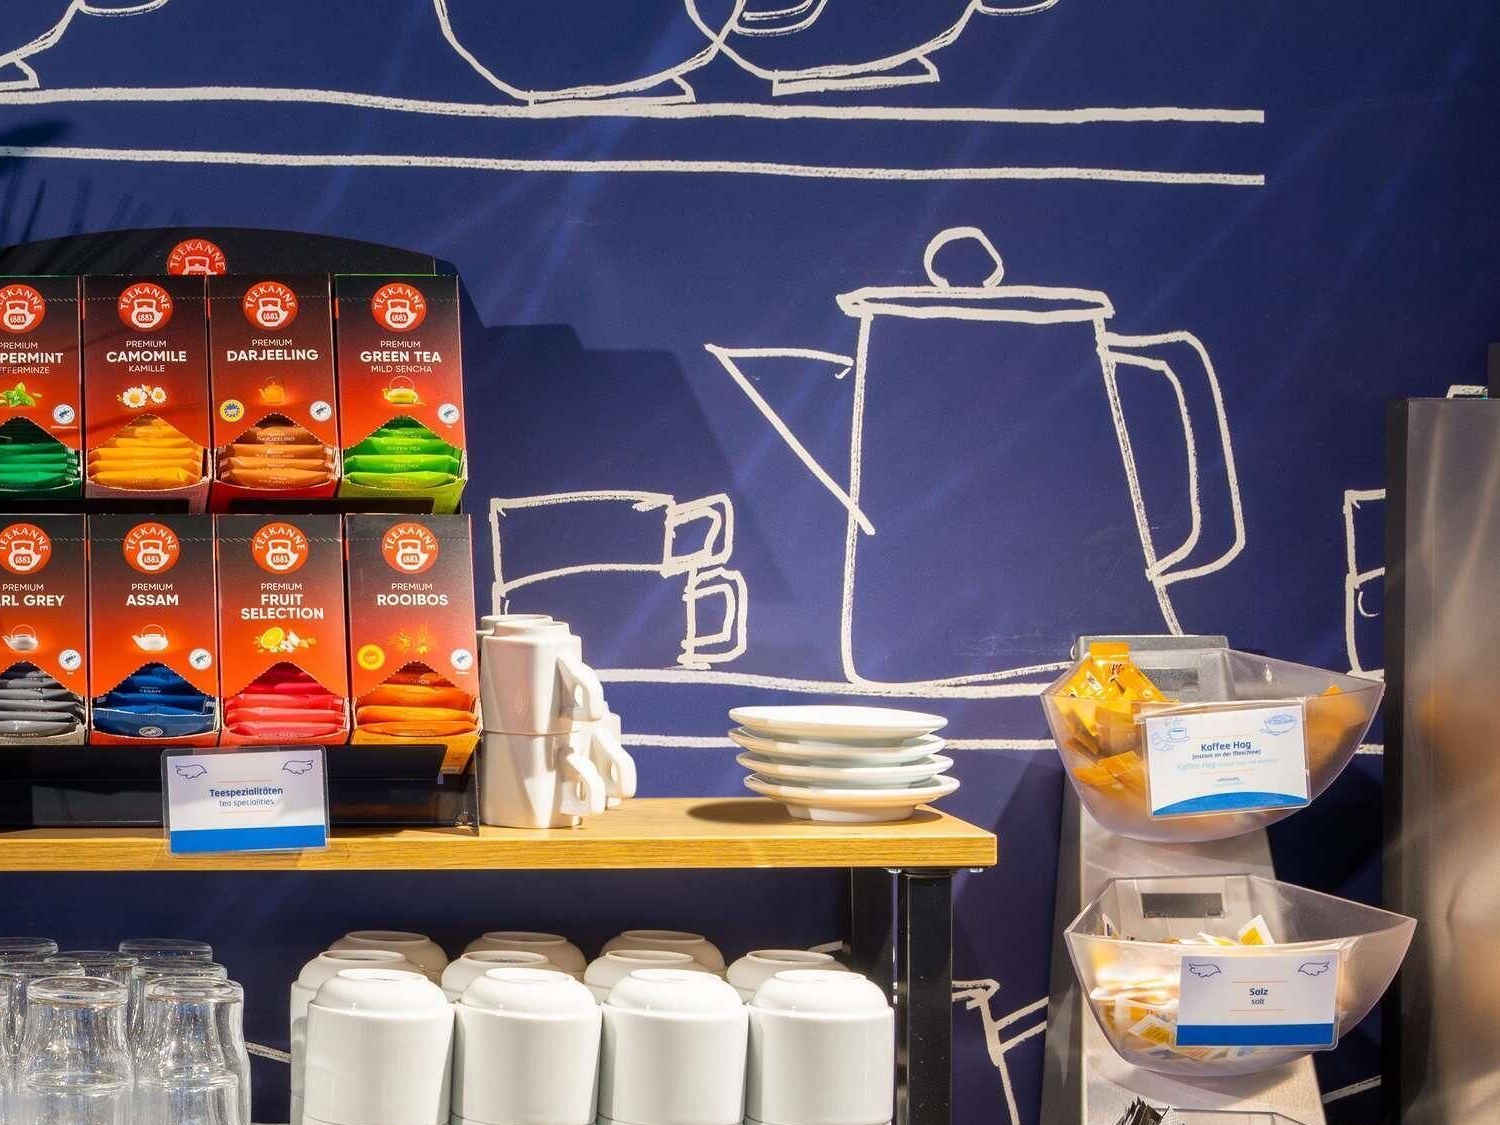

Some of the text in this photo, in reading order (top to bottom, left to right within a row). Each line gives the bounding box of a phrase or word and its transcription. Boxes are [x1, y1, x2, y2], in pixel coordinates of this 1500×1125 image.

[170, 241, 226, 270] TEEKANNE
[121, 286, 171, 310] TEEKANNE
[245, 285, 296, 309] TEEKANNE
[374, 287, 424, 311] TEEKANNE
[126, 340, 167, 348] PREMIUM
[252, 339, 292, 347] PREMIUM
[380, 340, 421, 348] PREMIUM
[106, 351, 187, 362] CAMOMILE
[227, 349, 319, 361] DARJEELING
[360, 351, 442, 363] GREEN TEA
[128, 365, 165, 373] KAMILLE
[371, 365, 433, 374] MILD SENCHA
[126, 528, 177, 552] TEEKANNE
[255, 527, 306, 552] TEEKANNE
[384, 527, 436, 551] TEEKANNE
[2, 583, 44, 591] PREMIUM
[131, 583, 173, 591] PREMIUM
[260, 583, 302, 591] PREMIUM
[391, 583, 433, 591] PREMIUM
[24, 595, 65, 606] GREY
[126, 594, 179, 606] ASSAM
[261, 594, 303, 605] FRUIT
[377, 594, 449, 605] ROOIBOS
[240, 607, 324, 620] SELECTION
[1201, 741, 1251, 751] Kaffee Hag
[209, 786, 283, 798] Teespezialitäten
[233, 798, 275, 808] specialities
[1249, 987, 1269, 996] Salz
